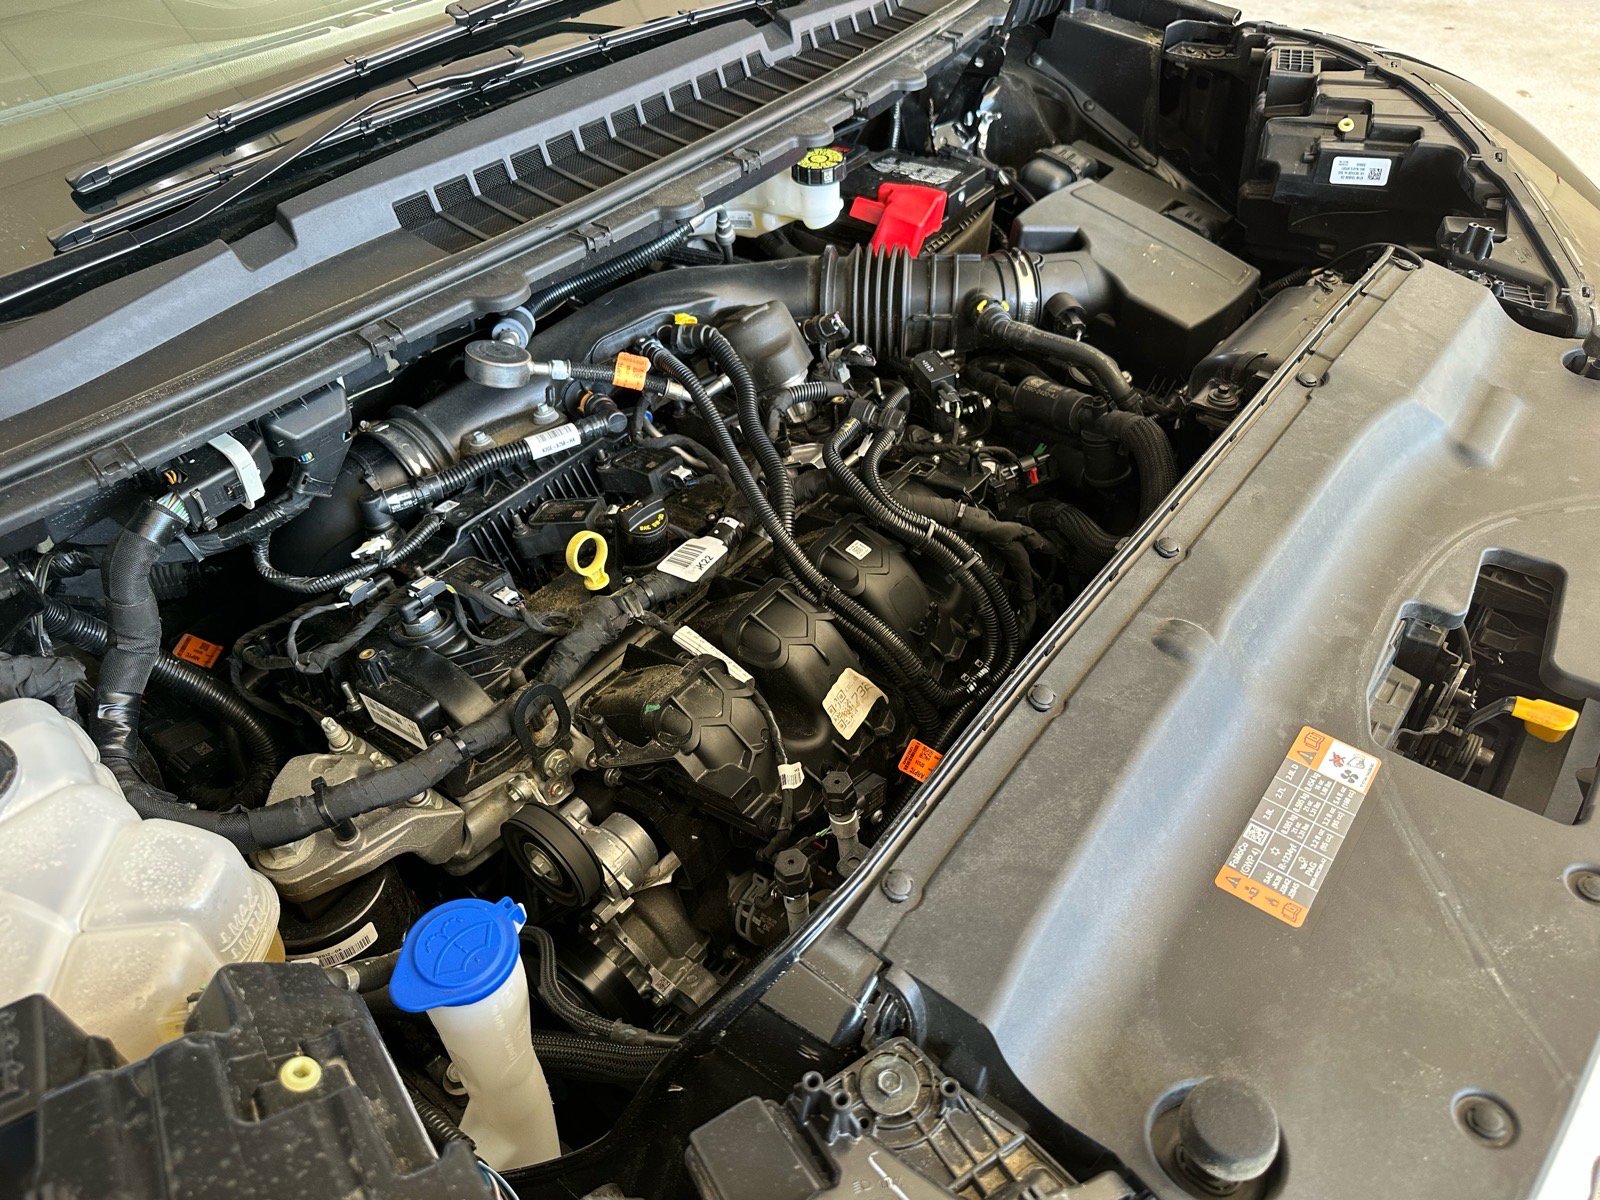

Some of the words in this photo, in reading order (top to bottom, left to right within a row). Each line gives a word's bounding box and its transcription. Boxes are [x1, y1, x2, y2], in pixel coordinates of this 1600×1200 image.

[1229, 842, 1249, 868] FoMoCo
[1240, 855, 1255, 875] (GWP
[1277, 843, 1298, 871] R-1234yf
[1263, 870, 1275, 885] SAE
[1304, 861, 1318, 877] PAG
